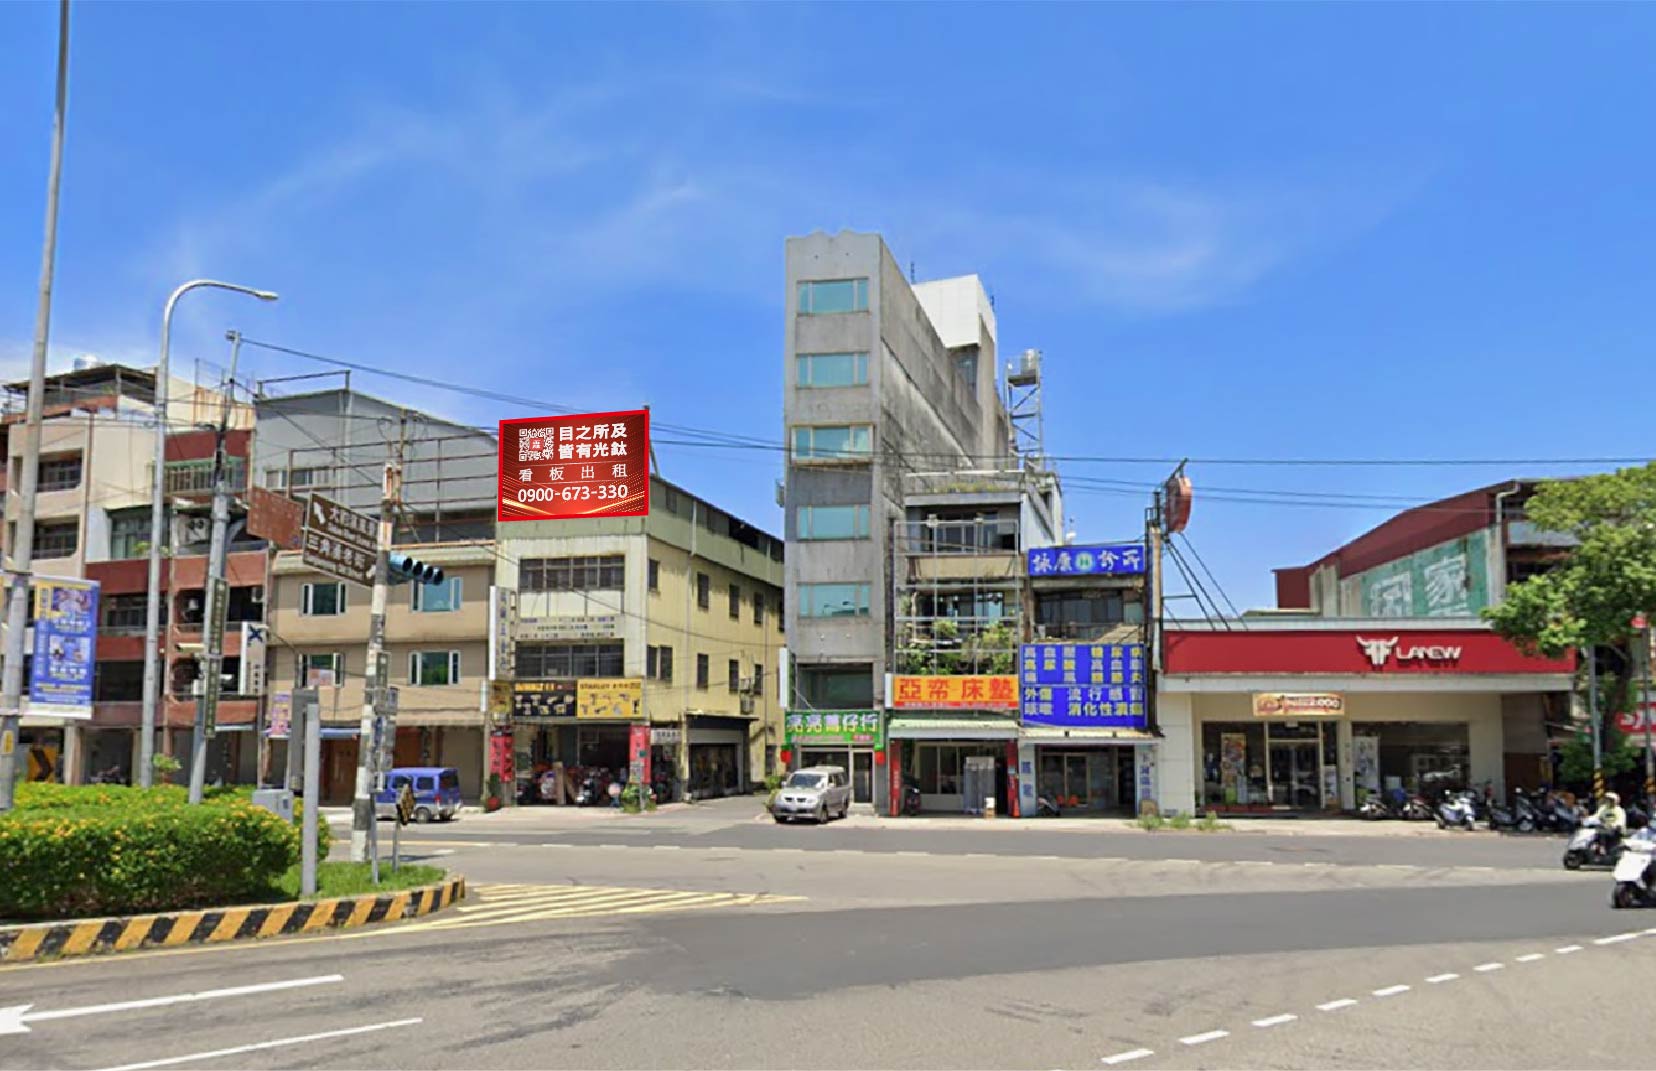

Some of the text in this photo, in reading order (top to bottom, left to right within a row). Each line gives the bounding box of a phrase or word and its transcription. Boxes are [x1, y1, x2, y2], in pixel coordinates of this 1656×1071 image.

[559, 423, 627, 441] 目之所及
[558, 441, 627, 459] 皆有光鈦
[519, 463, 628, 482] 看板出租
[517, 484, 628, 502] 0900-673-330
[1098, 549, 1140, 571] 診所
